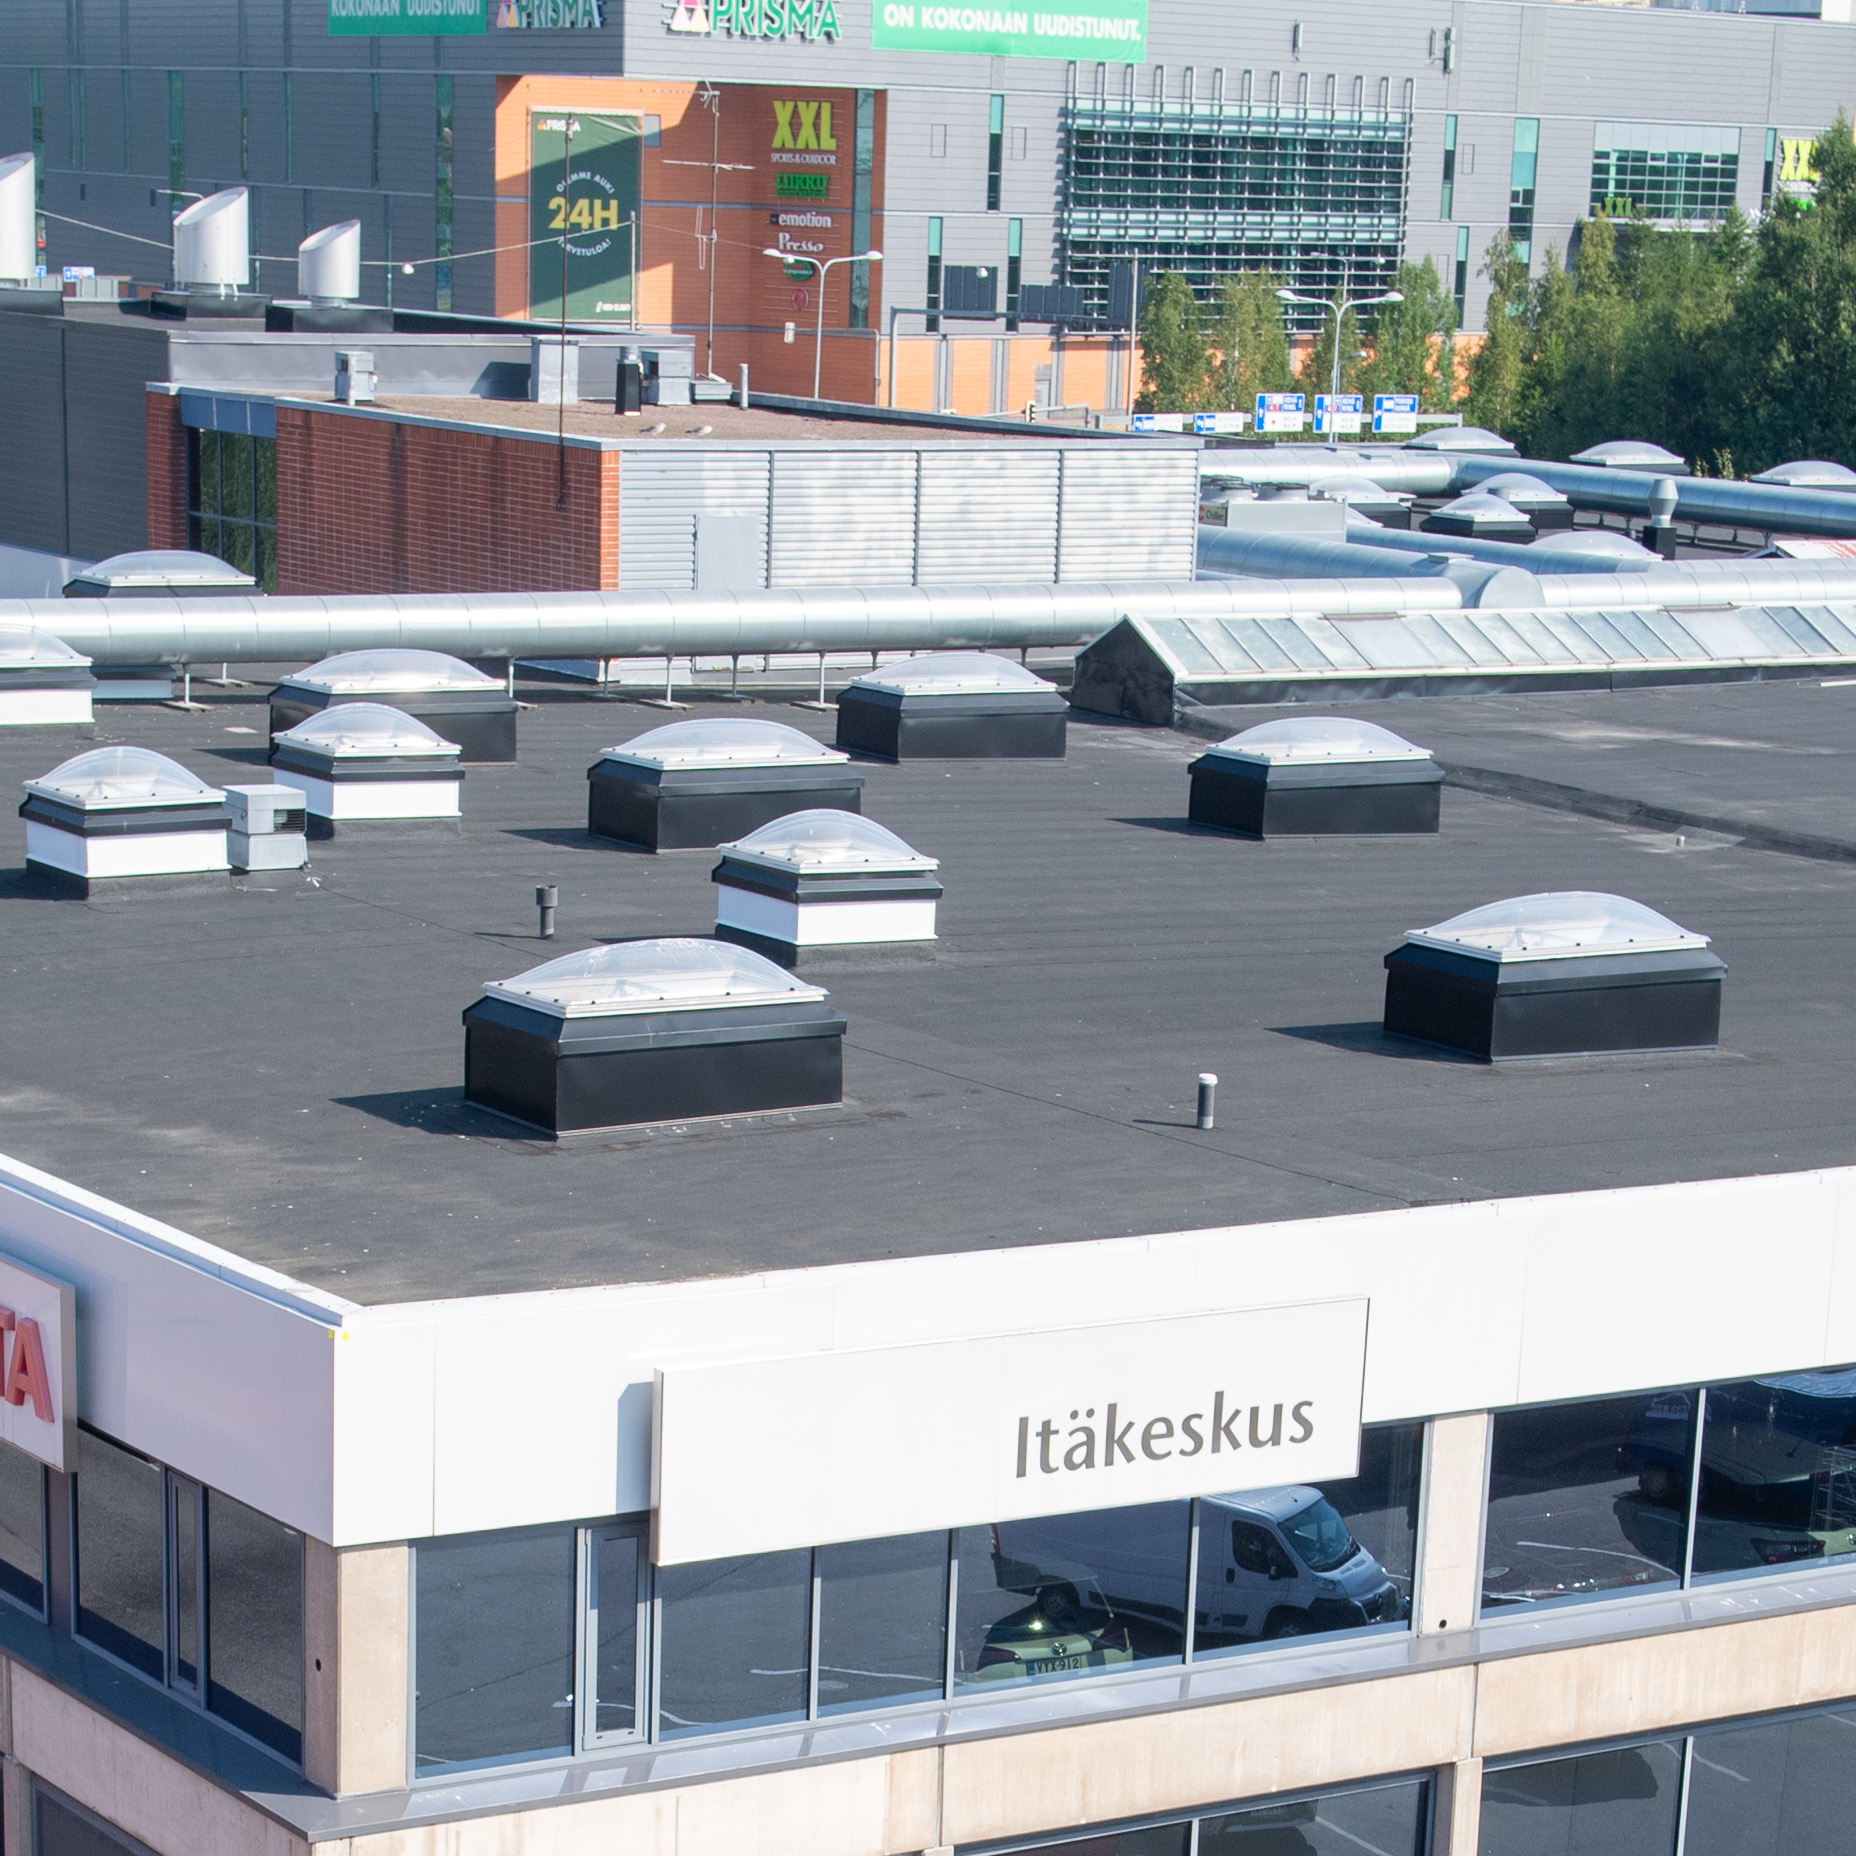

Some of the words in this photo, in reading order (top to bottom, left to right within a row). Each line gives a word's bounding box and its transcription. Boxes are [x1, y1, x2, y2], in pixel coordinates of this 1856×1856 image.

[518, 0, 601, 28] PRISMA
[710, 0, 842, 40] PRISMA
[883, 4, 914, 27] ON
[921, 7, 1027, 34] KOKONAAN
[1033, 14, 1142, 41] UUDISTUNUT.
[772, 101, 837, 150] XXL
[548, 196, 618, 230] 24H
[778, 212, 832, 228] emotion
[778, 232, 824, 252] Presso
[1016, 1390, 1315, 1479] Itäkeskus
